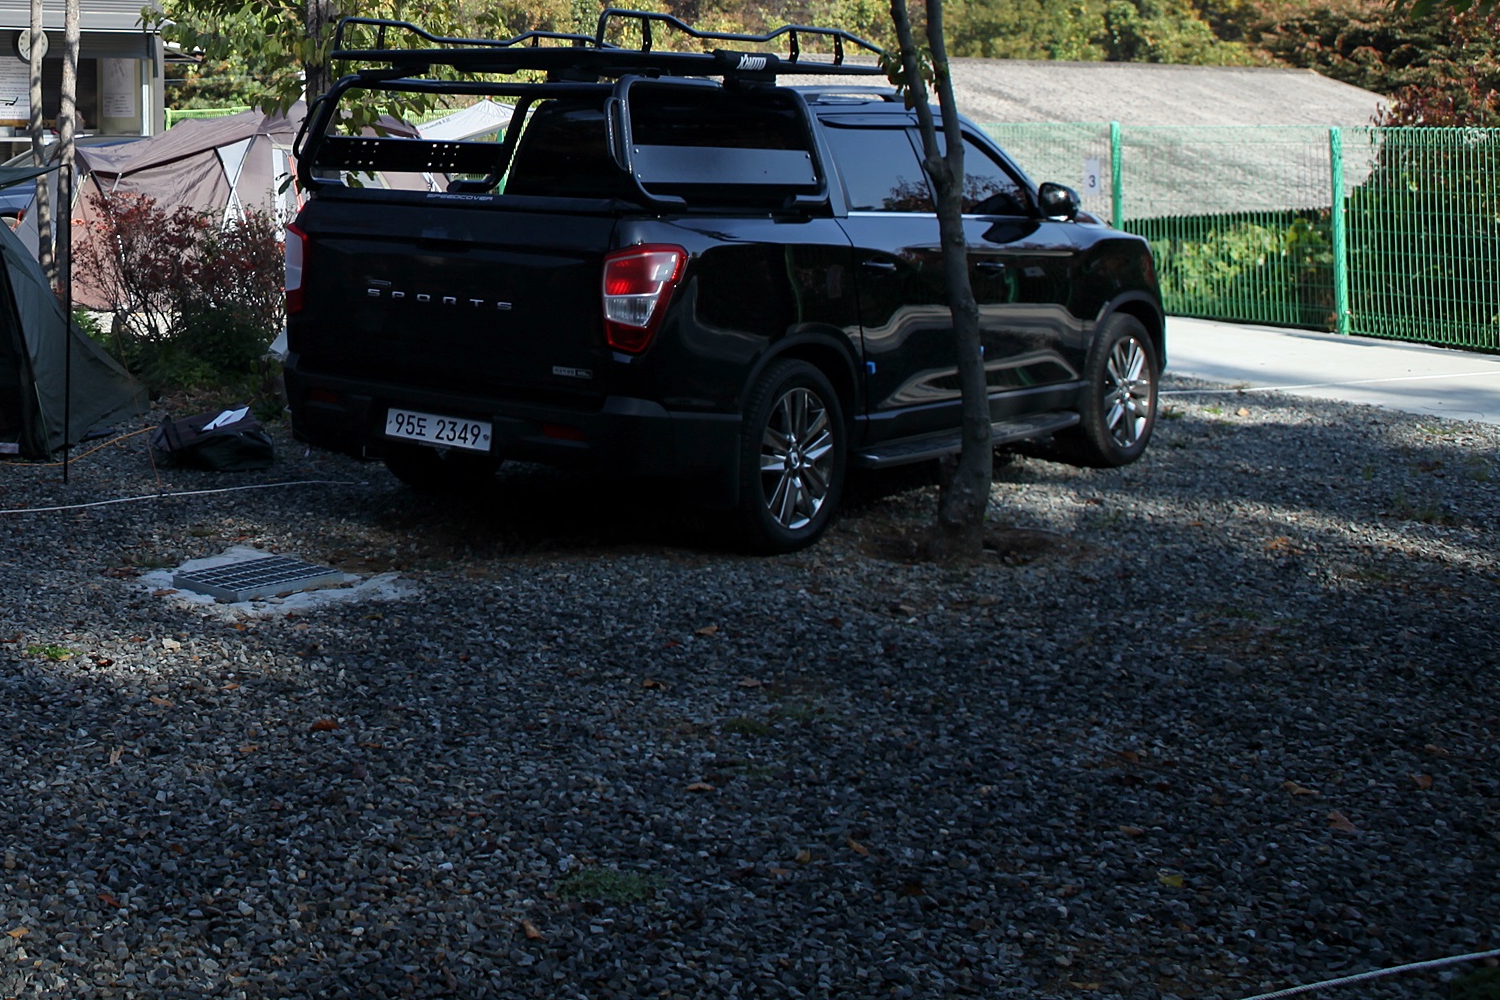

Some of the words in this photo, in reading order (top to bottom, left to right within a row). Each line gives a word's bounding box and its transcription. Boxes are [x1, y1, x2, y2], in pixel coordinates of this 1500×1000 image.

[1088, 174, 1096, 188] 3
[426, 193, 494, 201] SPEEDCOVER
[366, 288, 513, 311] SPORTS
[395, 412, 427, 437] 95도
[435, 419, 481, 446] 2349
